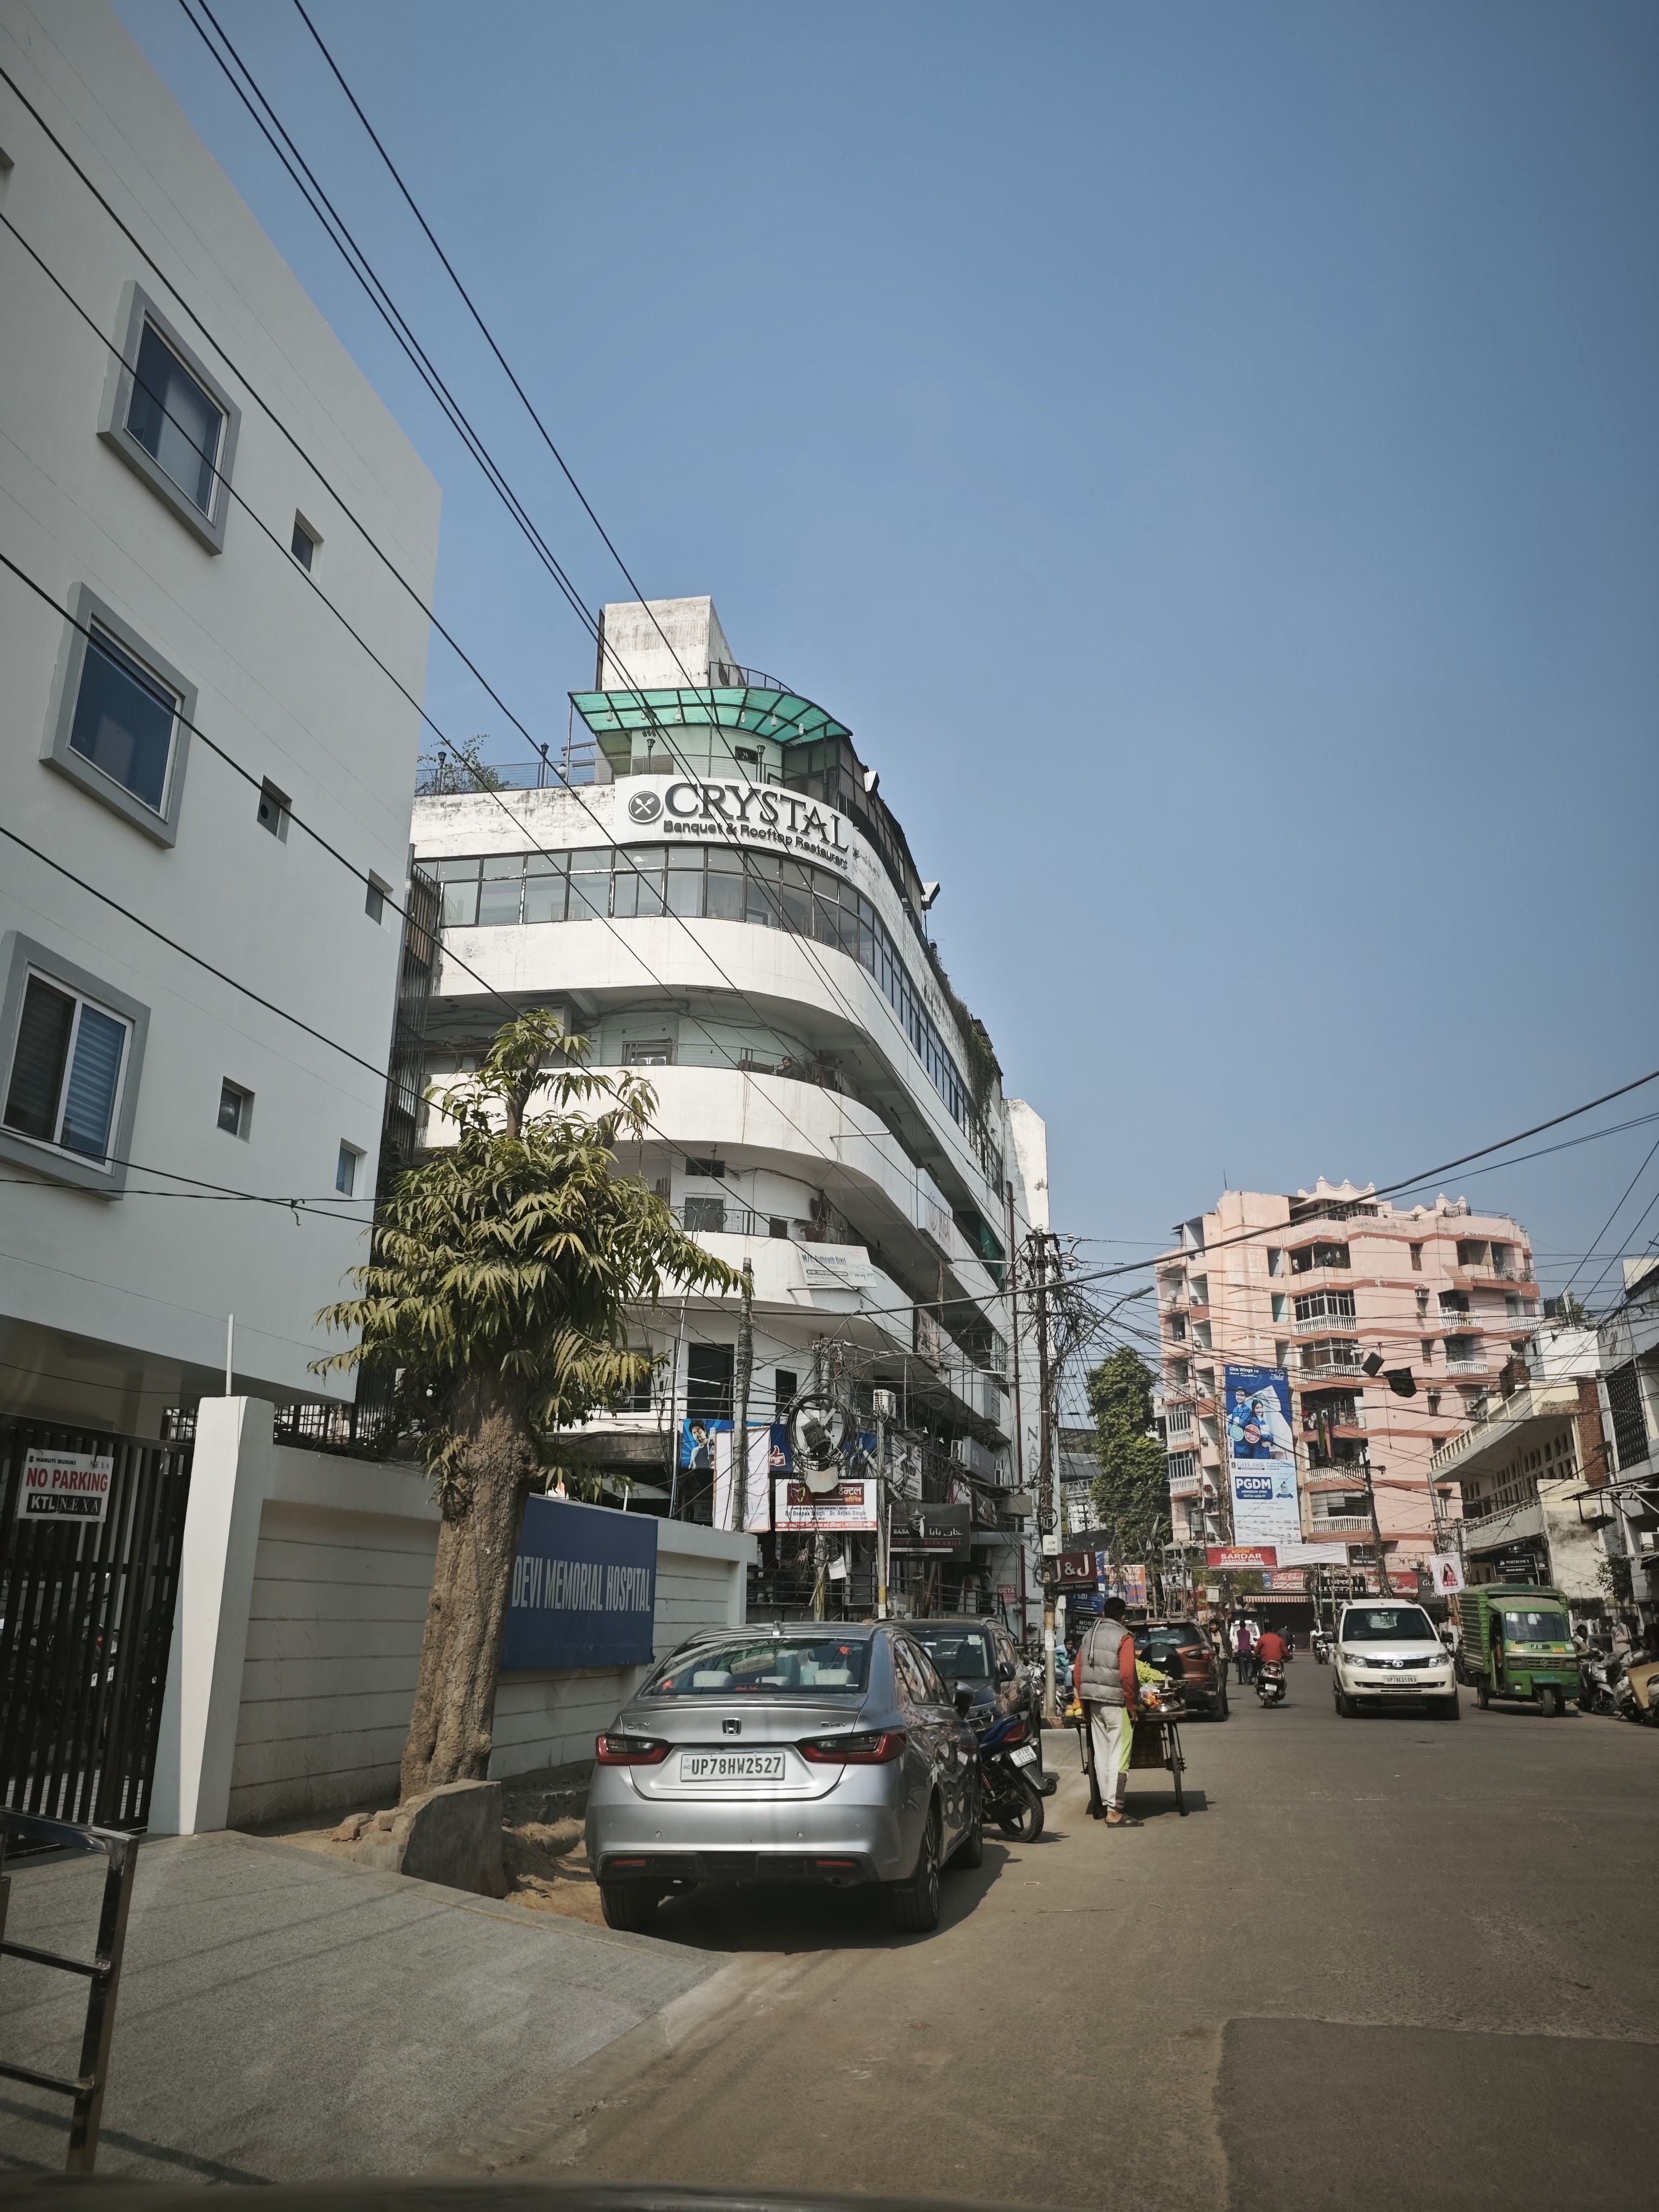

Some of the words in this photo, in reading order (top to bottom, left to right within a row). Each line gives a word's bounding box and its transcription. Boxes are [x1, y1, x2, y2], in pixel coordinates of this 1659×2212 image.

[665, 783, 849, 853] CRYSTAL
[664, 820, 723, 835] Banquet
[726, 823, 737, 835] &
[740, 824, 792, 846] Rooftop
[795, 837, 848, 870] Restaurant
[90, 1461, 110, 1469] NEXA
[26, 1467, 48, 1488] NO
[52, 1469, 108, 1493] PARKING
[1236, 1478, 1271, 1489] PGDM
[31, 1495, 55, 1510] KTL
[60, 1498, 98, 1512] NEXA
[692, 1757, 781, 1775] UP78HW2527
